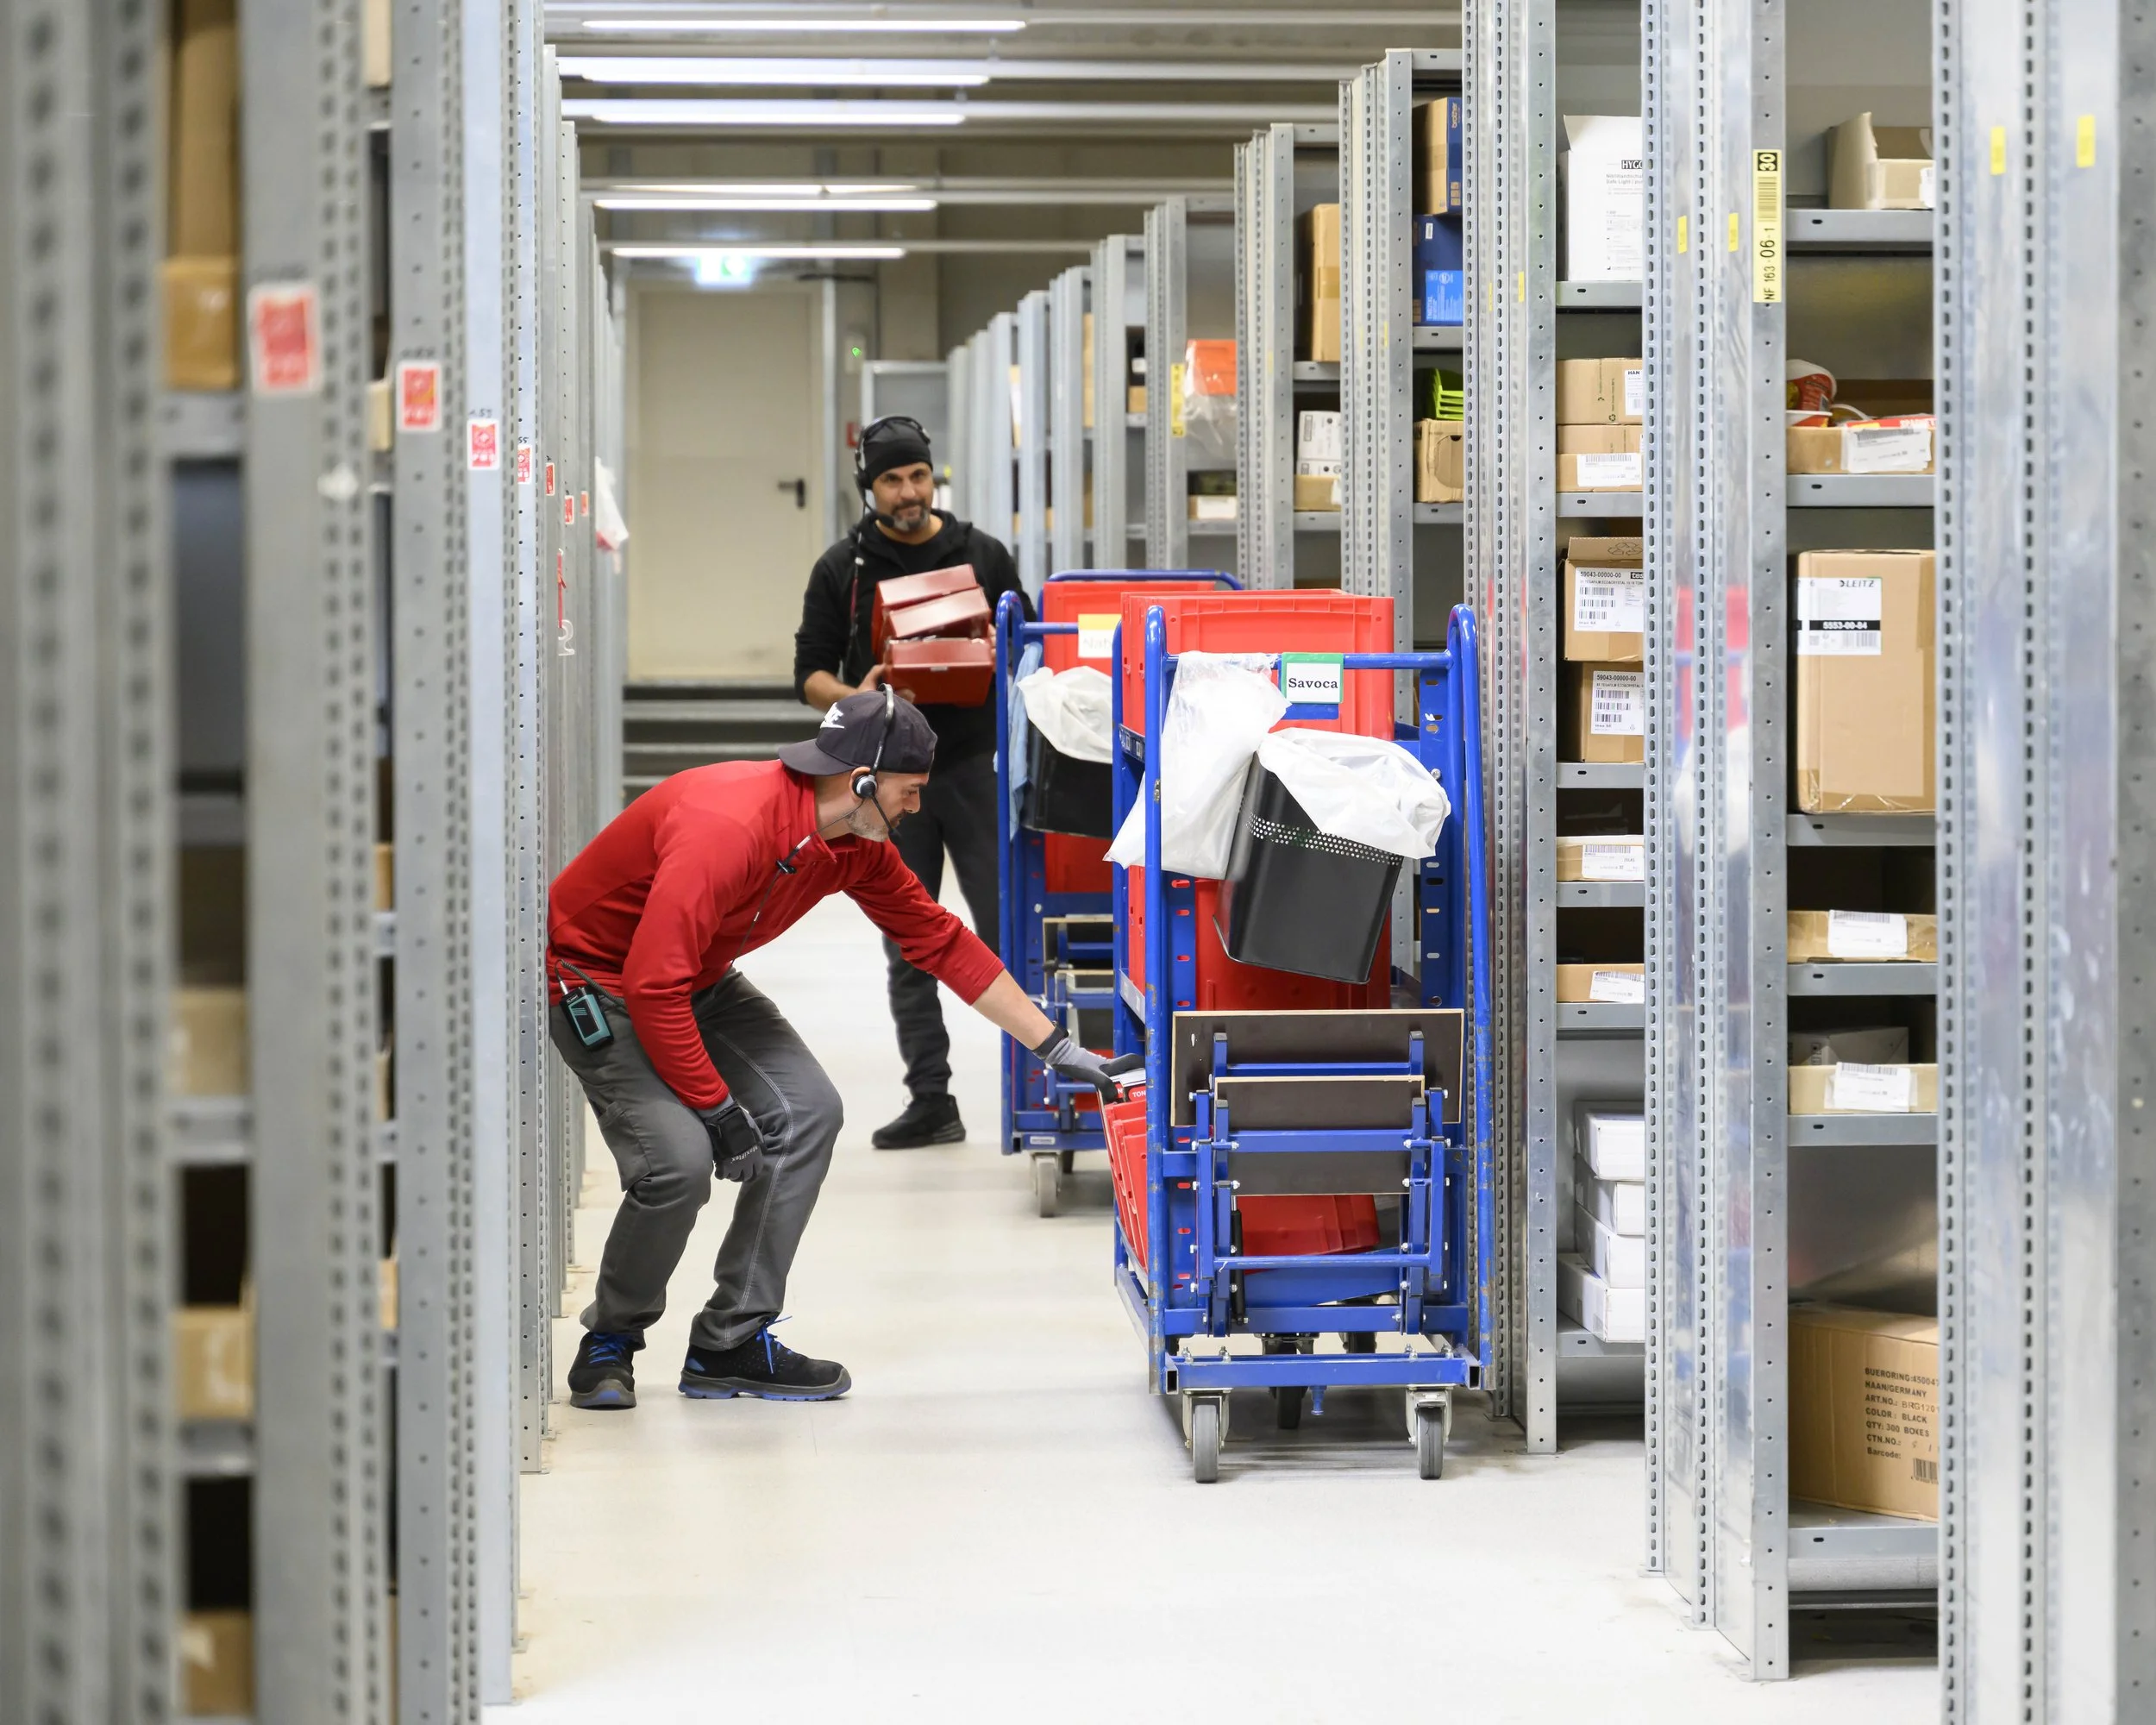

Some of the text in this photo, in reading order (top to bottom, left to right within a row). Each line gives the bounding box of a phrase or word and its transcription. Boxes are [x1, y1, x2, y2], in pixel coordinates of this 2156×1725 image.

[1758, 153, 1777, 171] 30
[1764, 287, 1775, 300] NF
[1288, 677, 1338, 688] Savoca
[1865, 1381, 1927, 1397] HAAN/GERMANY
[1902, 1413, 1927, 1424] BLACK
[1866, 1421, 1930, 1438] QTY: 300 BOXES
[1867, 1446, 1902, 1458] Barcode:
